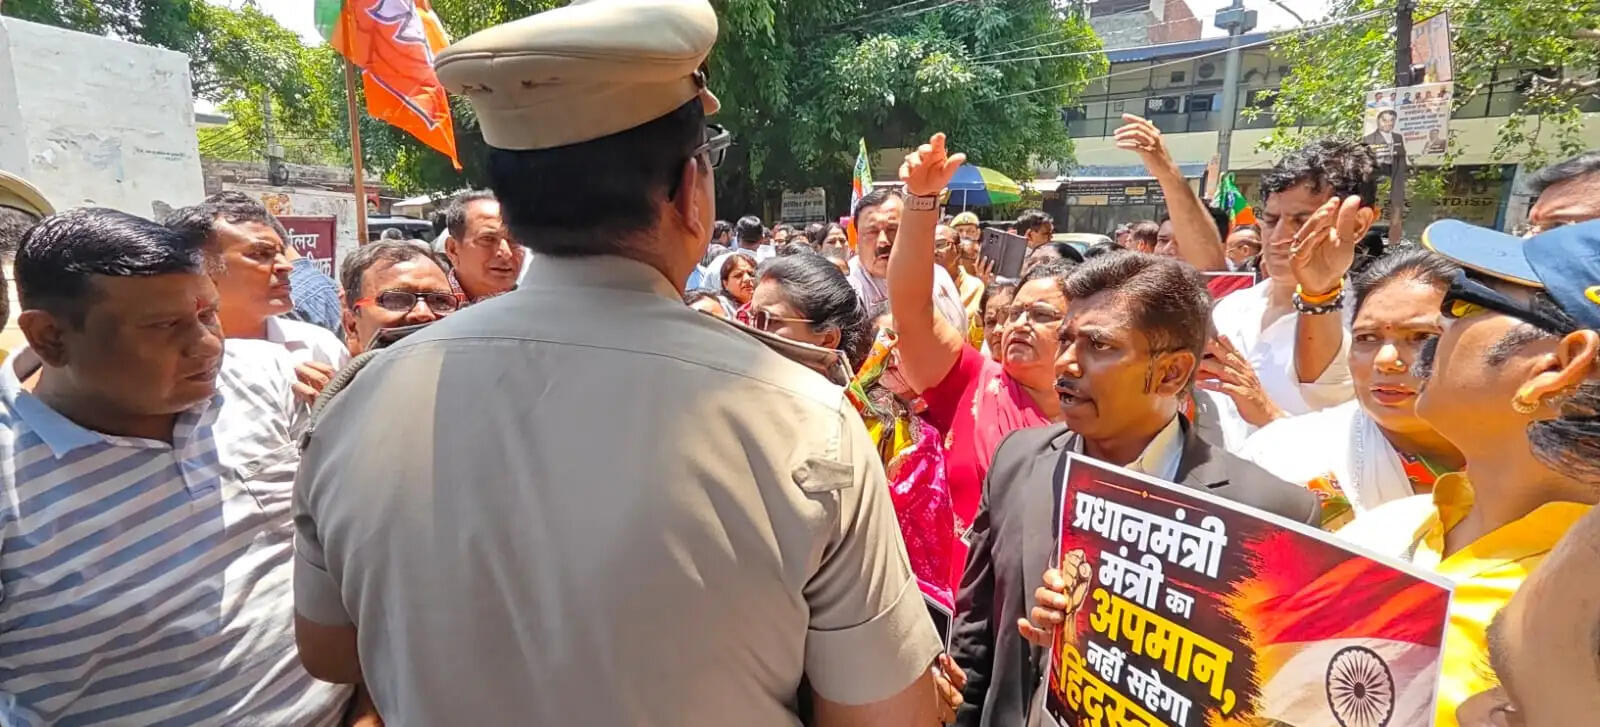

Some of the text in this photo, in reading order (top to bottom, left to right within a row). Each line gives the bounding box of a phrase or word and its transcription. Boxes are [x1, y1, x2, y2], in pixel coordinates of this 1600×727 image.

[1072, 491, 1228, 579] प्रधानमंत्री
[1098, 545, 1195, 619] मंत्री का
[1086, 640, 1193, 727] नहीं सहेगा
[1090, 587, 1236, 715] अपमान,
